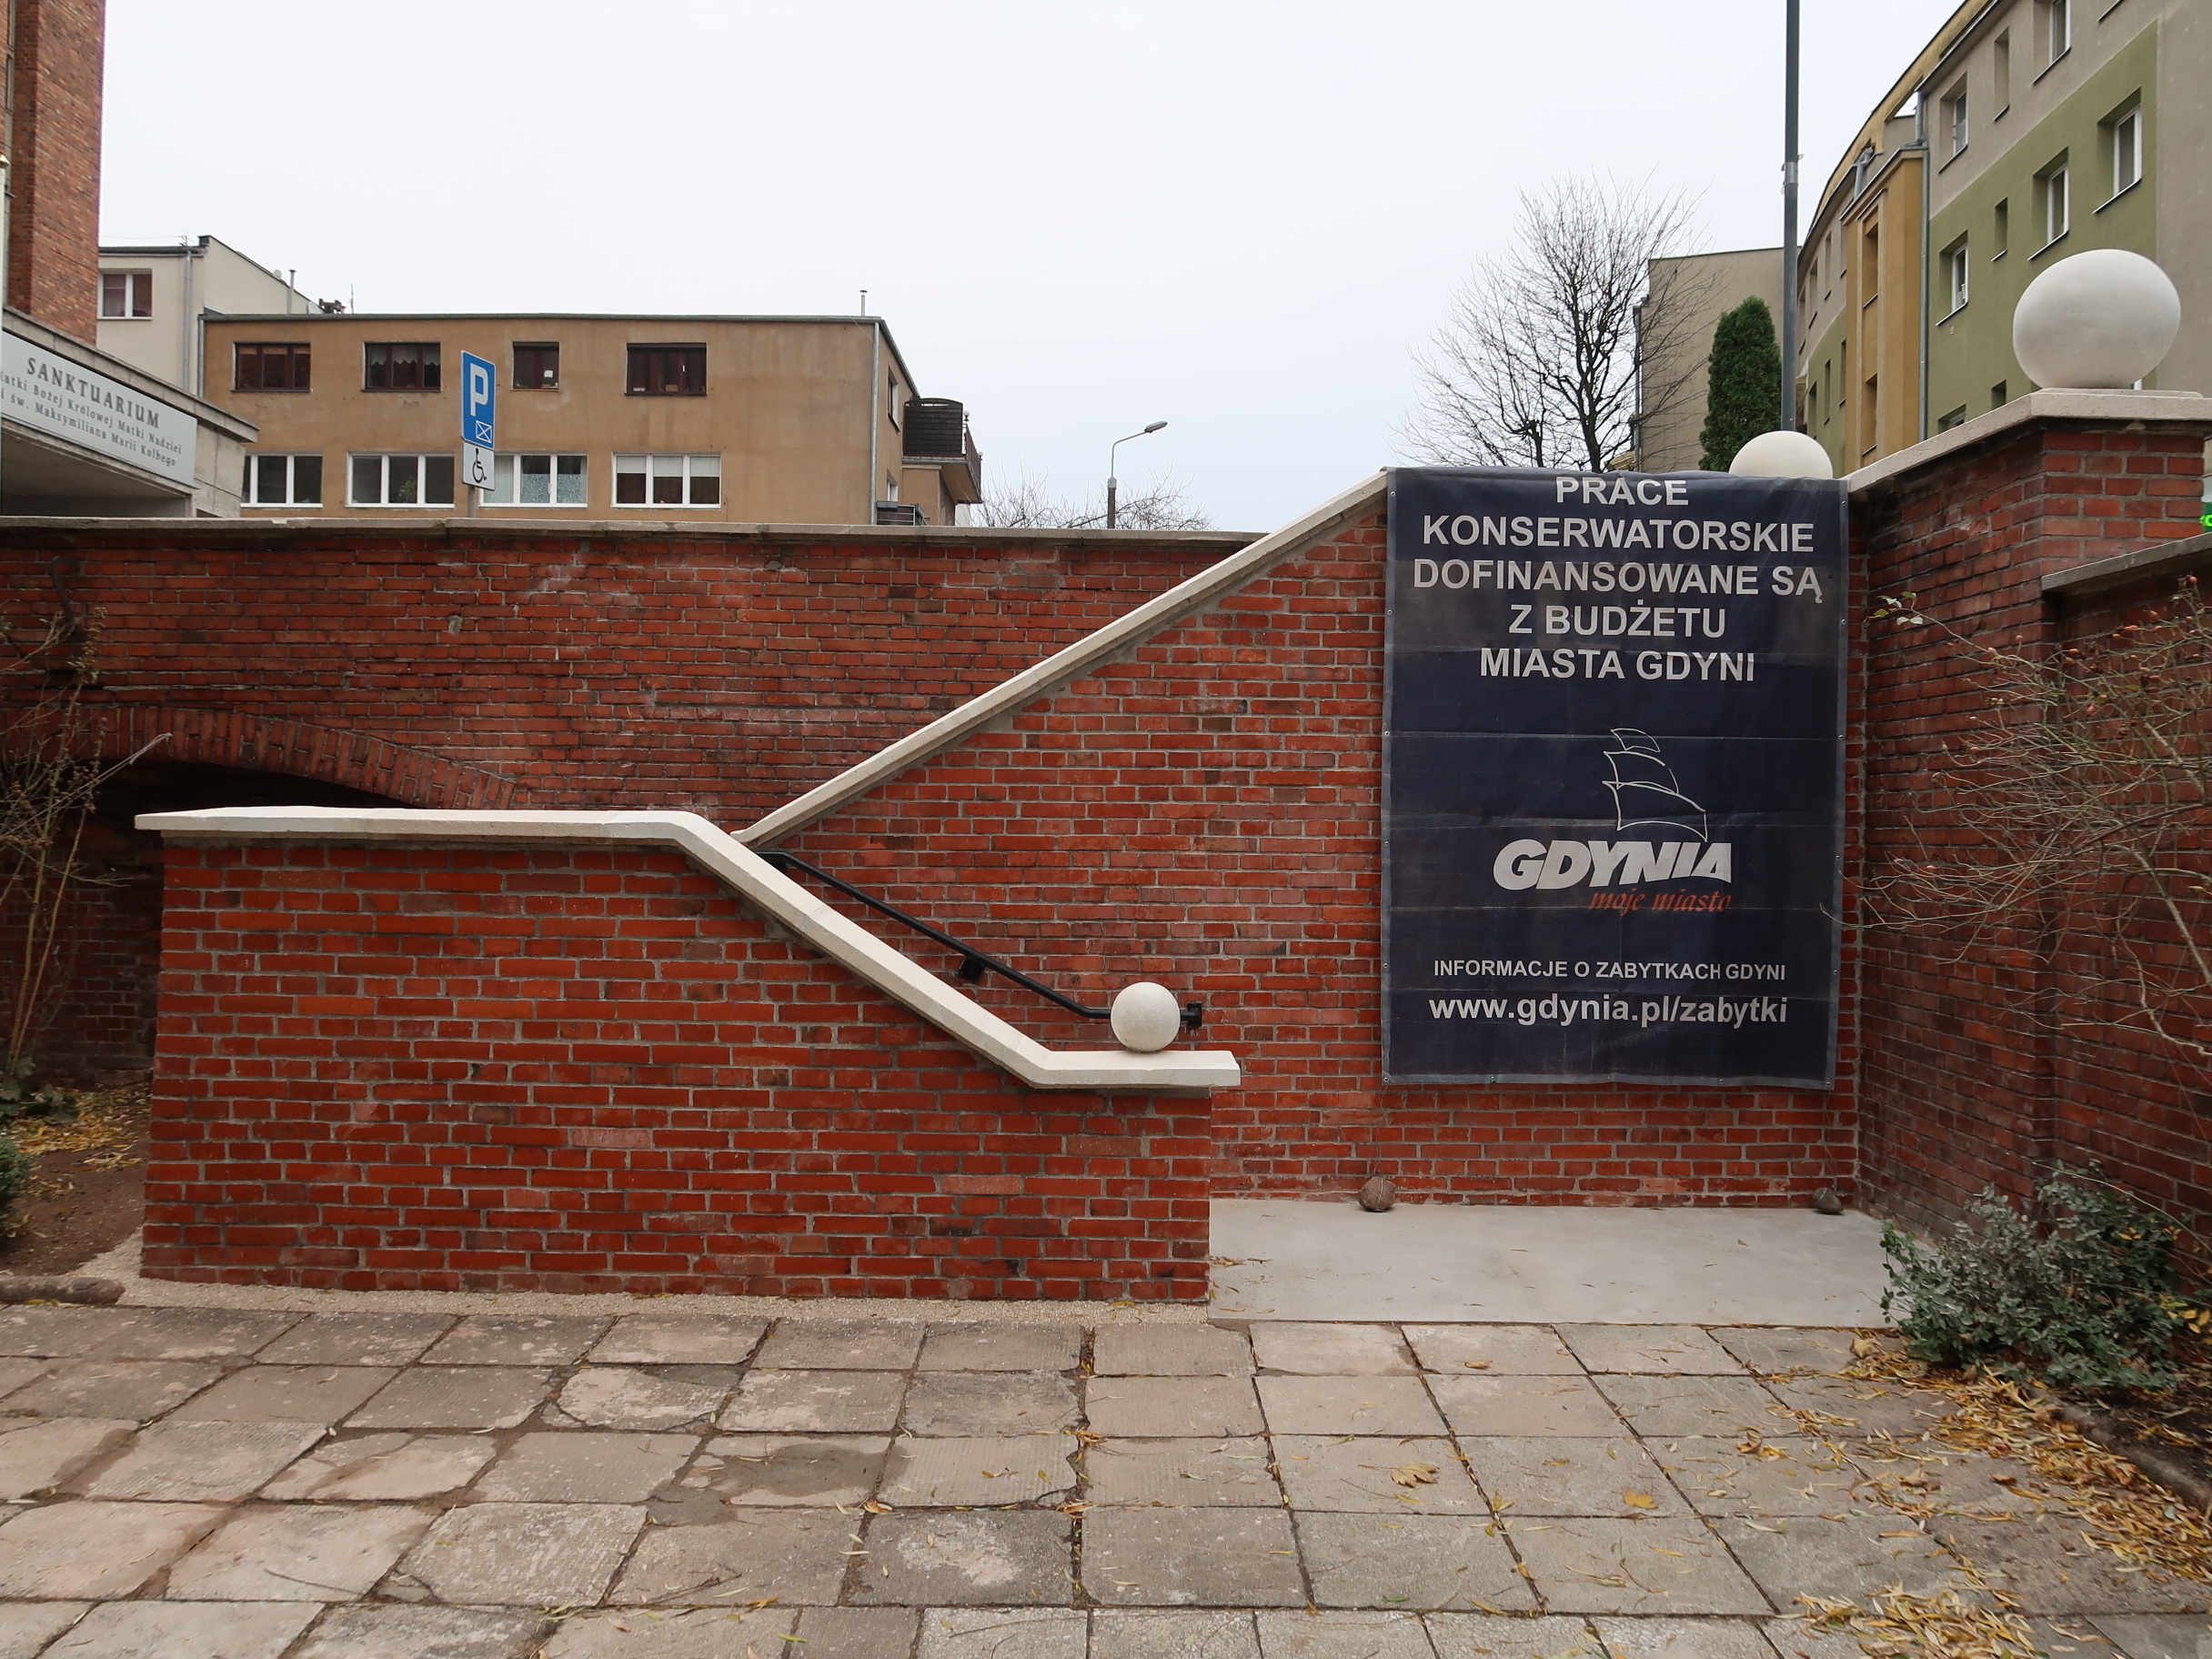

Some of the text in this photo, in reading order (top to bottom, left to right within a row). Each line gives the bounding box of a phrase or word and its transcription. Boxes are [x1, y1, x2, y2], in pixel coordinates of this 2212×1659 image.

[26, 357, 159, 428] SANKTUARIUM
[469, 362, 488, 417] P
[10, 394, 30, 409] św.
[35, 402, 106, 439] Maksymiliana
[111, 432, 136, 452] Marii
[140, 444, 176, 468] Kolbego
[33, 384, 64, 408] Bożej
[67, 398, 114, 428] Królowej
[117, 419, 145, 439] Matki
[148, 432, 183, 455] Nadziei
[1555, 477, 1689, 507] PRACE
[1423, 515, 1815, 553] KONSERWATORSKIE
[1413, 558, 1824, 604] DOFINANSOWANE SĄ
[1508, 598, 1726, 638] Z BUDŻETU
[1479, 648, 1755, 682] MIASTA GDYNI
[1493, 839, 1733, 890] GDYNIA
[1587, 890, 1731, 916] moje miasto
[1433, 960, 1786, 981] INFORMACJE O ZABYTKACH GDYNI
[1428, 993, 1787, 1030] www.gdynia.pl/zabytki
